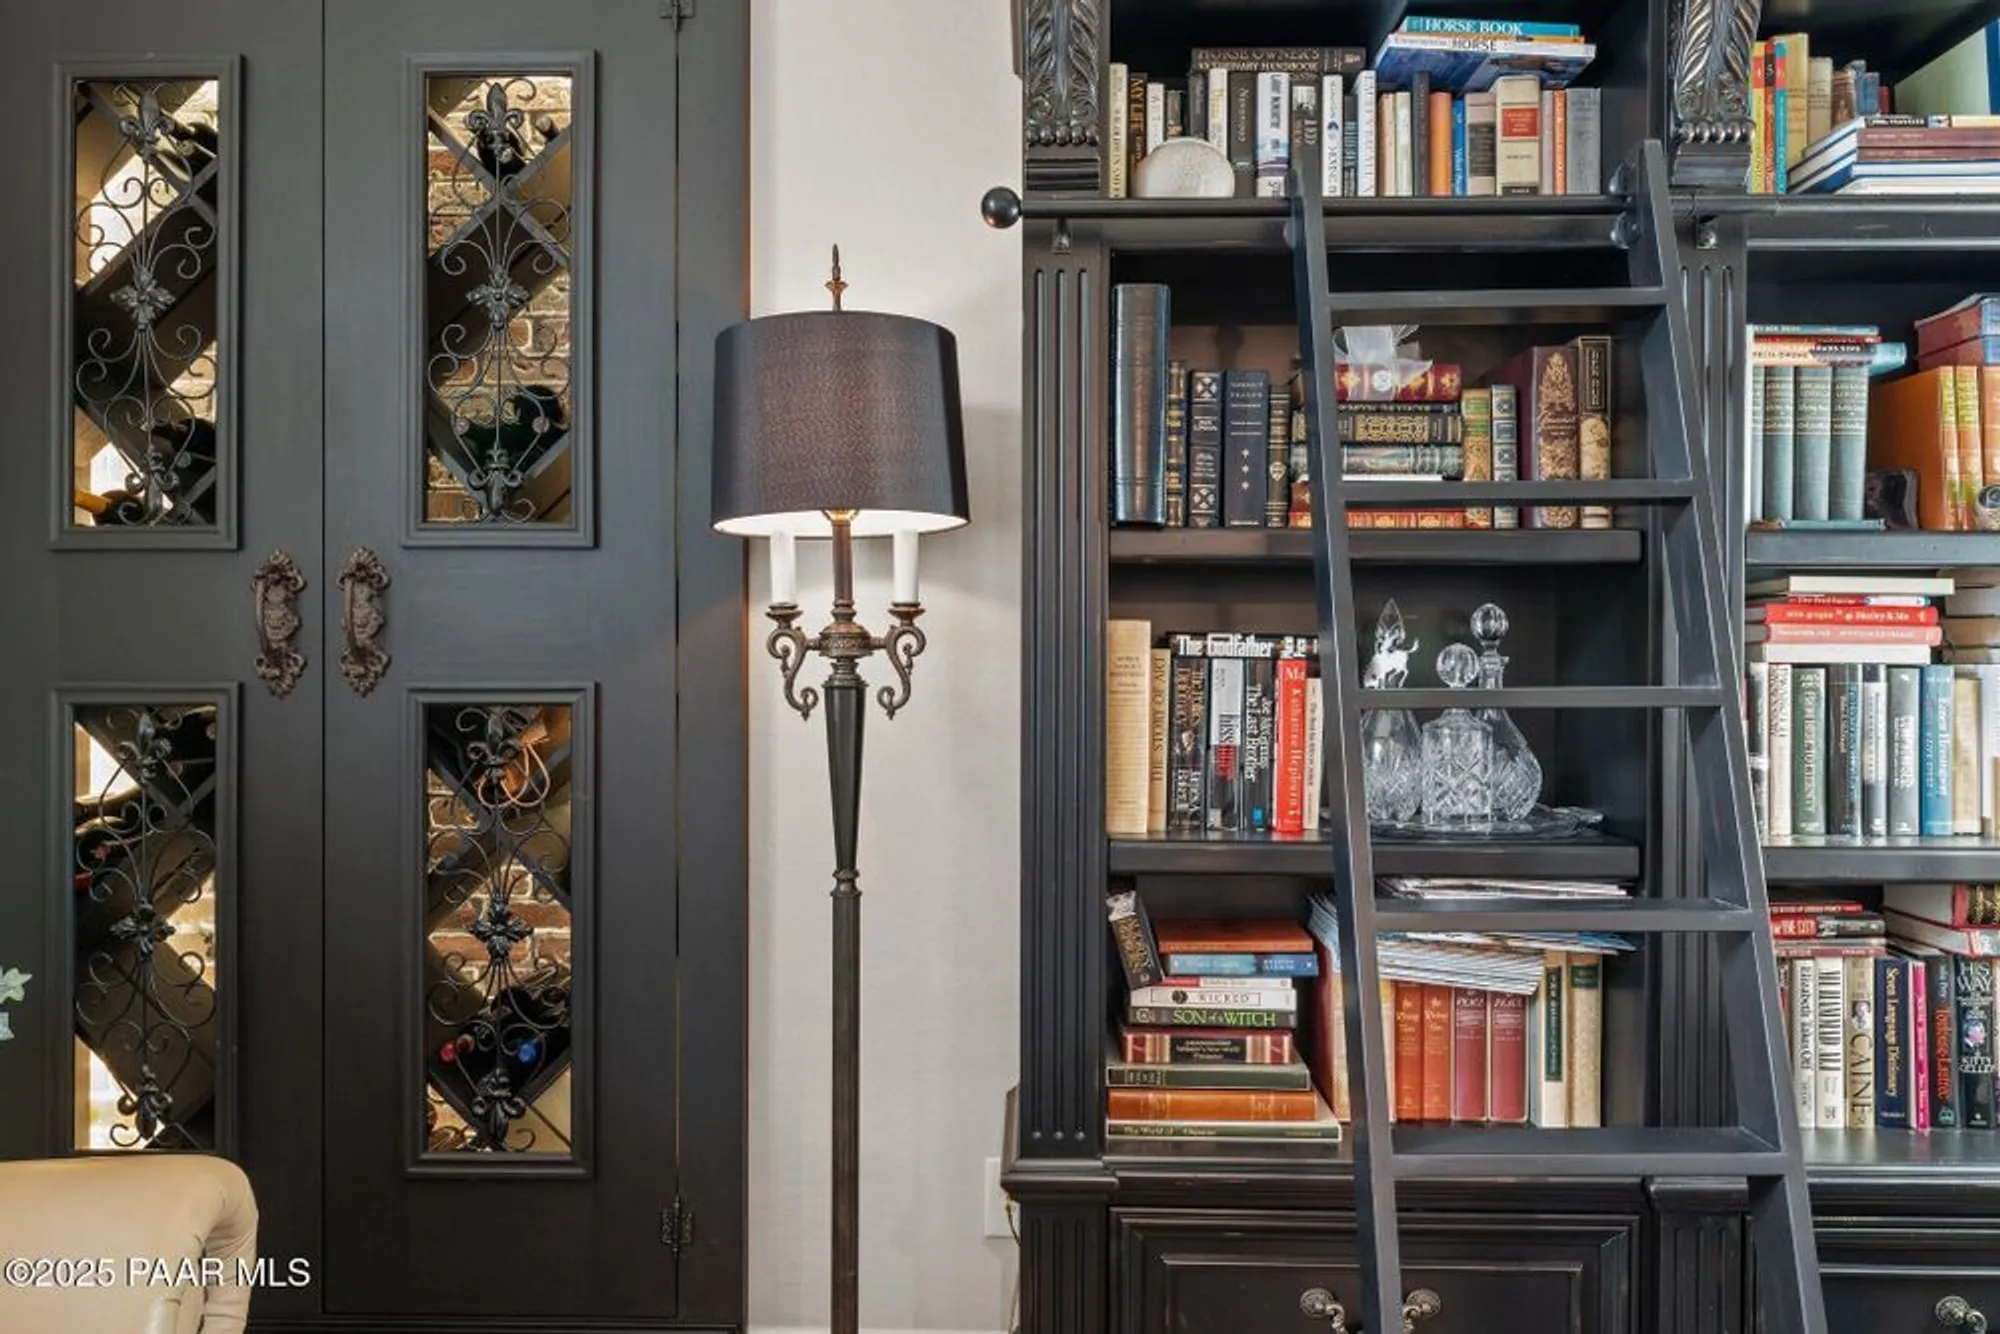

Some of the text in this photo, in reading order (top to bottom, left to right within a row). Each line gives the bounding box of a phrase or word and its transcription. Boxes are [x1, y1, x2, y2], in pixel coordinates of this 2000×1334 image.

[1426, 18, 1524, 35] HORSE BOOK
[1198, 48, 1320, 61] HORSE OWNER'S
[1452, 38, 1498, 51] HORSE
[1130, 78, 1144, 101] MY
[1176, 632, 1274, 658] The Godfather
[1152, 657, 1166, 684] ART
[1261, 696, 1272, 715] Joe
[1152, 707, 1165, 752] STORY
[1245, 684, 1262, 782] The Last Brother
[1151, 759, 1164, 783] THE
[1960, 963, 1989, 976] HIS
[1799, 966, 1813, 1018] Elizabeth
[1957, 976, 1993, 992] WAY
[1173, 1010, 1207, 1025] SON
[1224, 1011, 1276, 1027] WITCH
[1818, 970, 1841, 1071] MUHAMMAD ALI
[1884, 998, 1900, 1045] Language
[1851, 1034, 1872, 1113] CAINE
[1884, 1046, 1900, 1098] Dictionary
